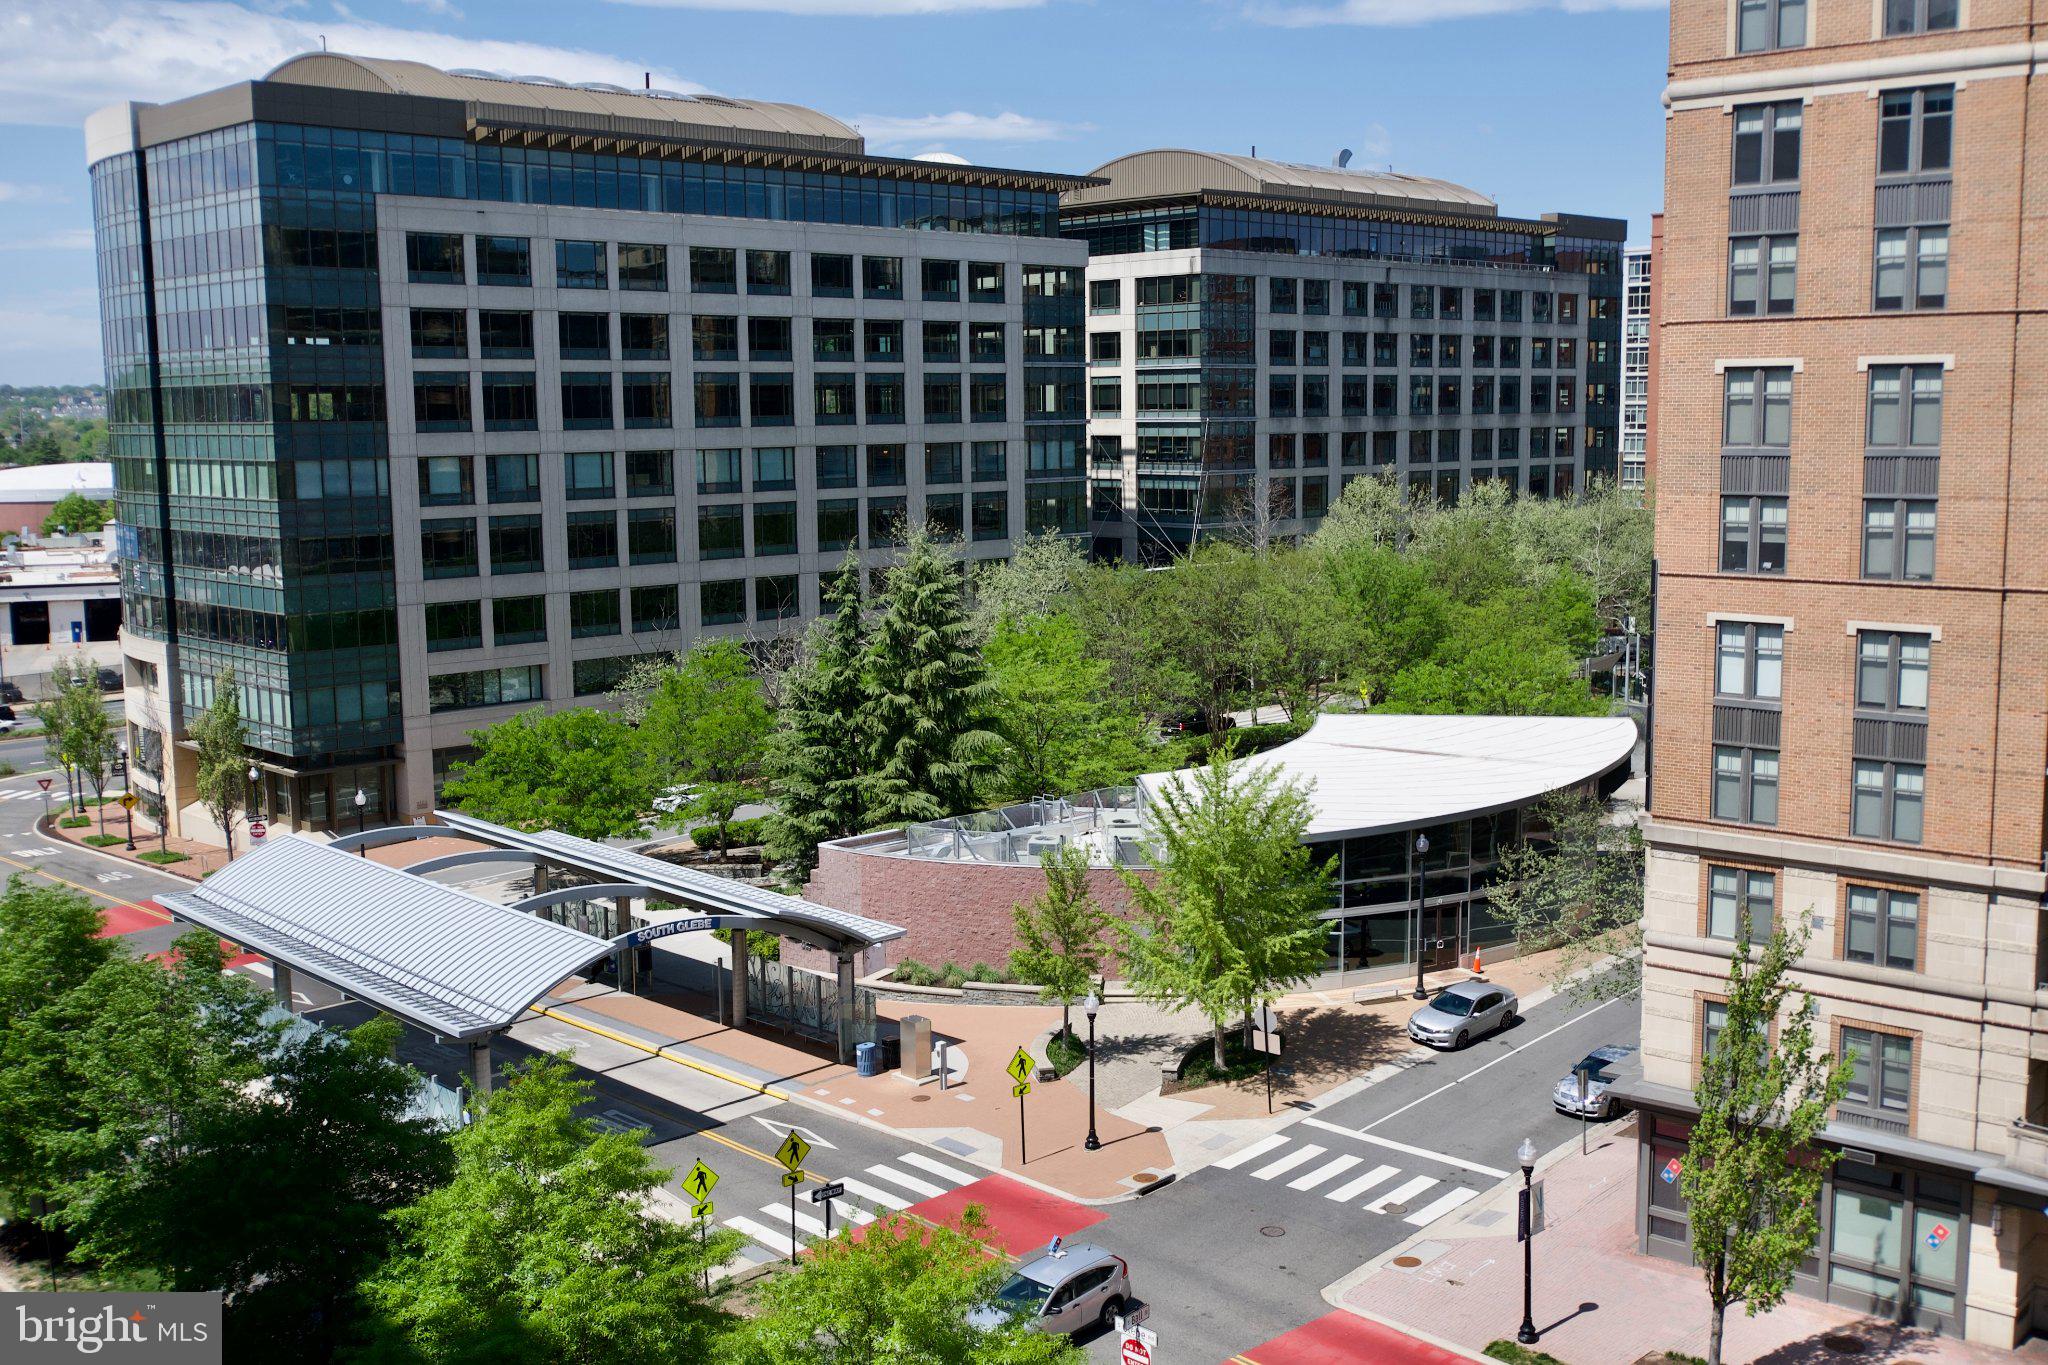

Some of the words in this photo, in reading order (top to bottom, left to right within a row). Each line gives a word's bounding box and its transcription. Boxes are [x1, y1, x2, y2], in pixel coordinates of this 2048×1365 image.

[637, 923, 675, 942] SOUTH
[676, 918, 713, 932] GLEBE
[1131, 1309, 1143, 1325] Ball
[1125, 1342, 1134, 1350] DO
[1134, 1346, 1147, 1356] NOT
